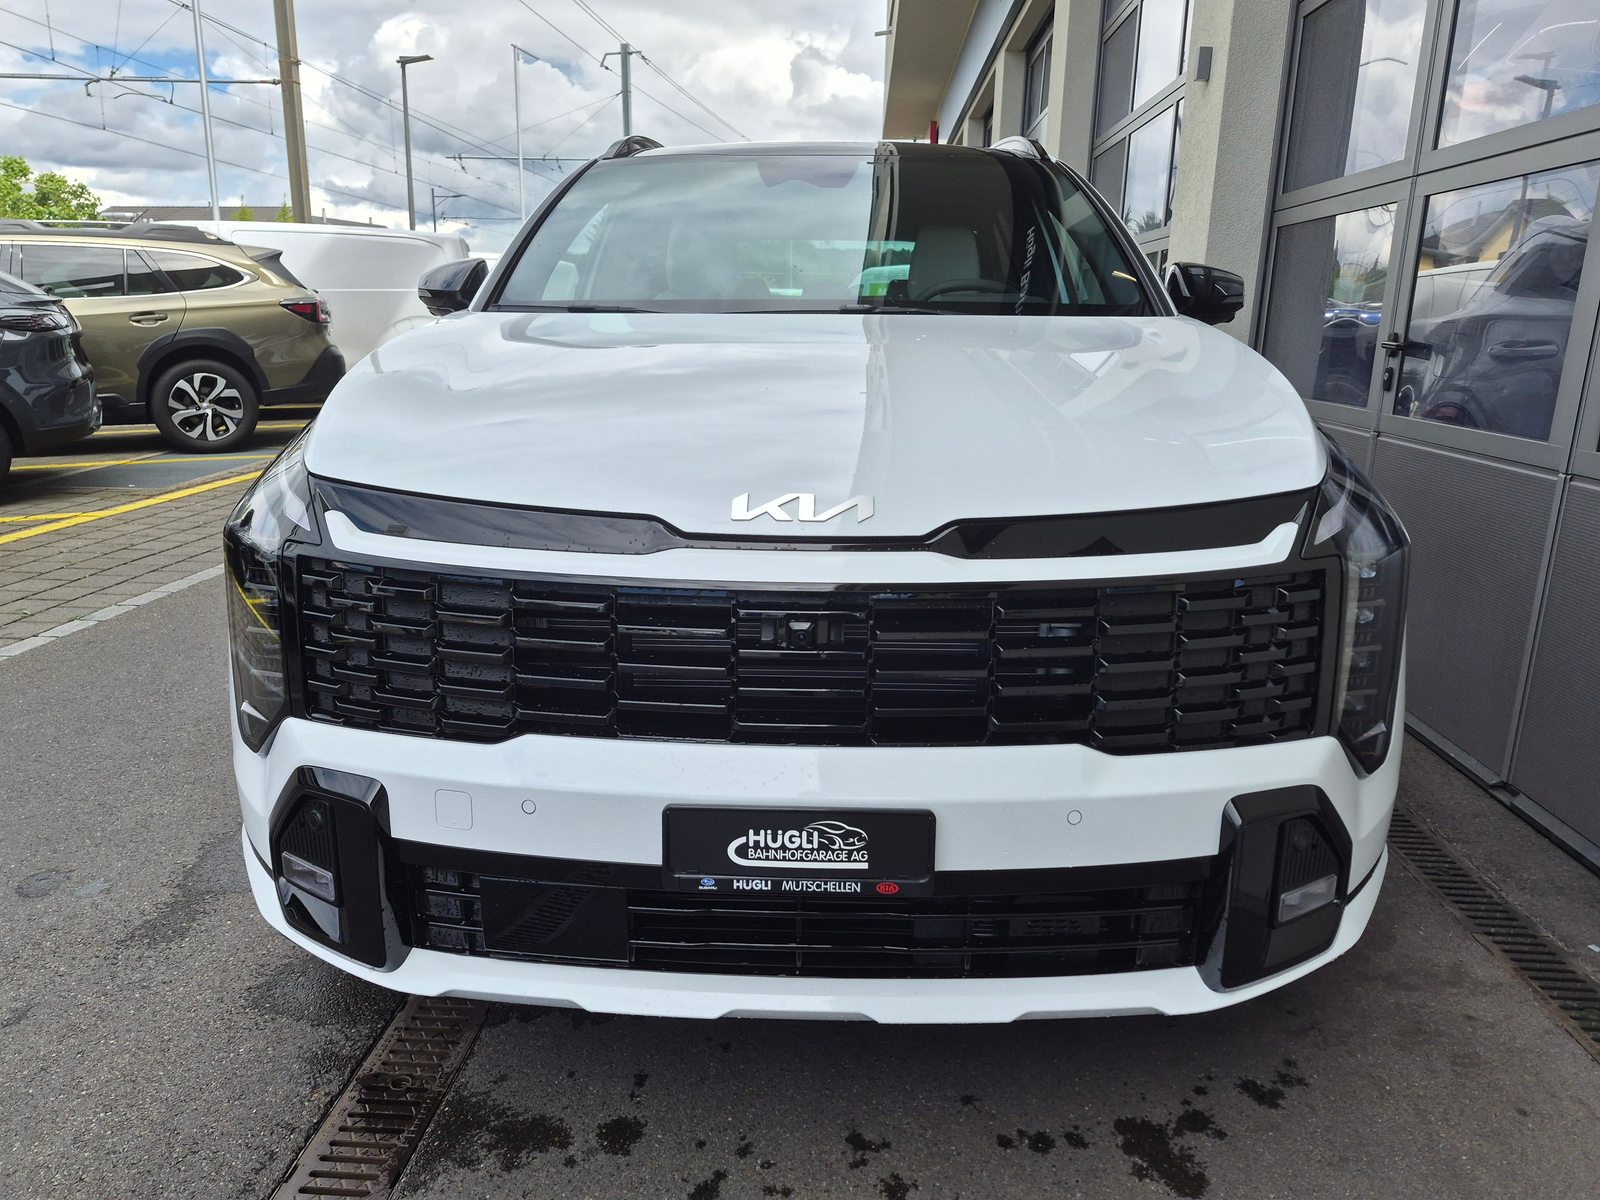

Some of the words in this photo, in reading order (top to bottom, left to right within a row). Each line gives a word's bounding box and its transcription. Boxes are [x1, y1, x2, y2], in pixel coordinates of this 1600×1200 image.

[731, 492, 875, 524] KIA
[748, 829, 819, 849] HÜGLI
[748, 848, 848, 861] BAHNHOFGARAGE
[850, 850, 869, 861] AG
[733, 879, 771, 891] HÜGLI
[781, 880, 861, 893] MUTSCHELLEN
